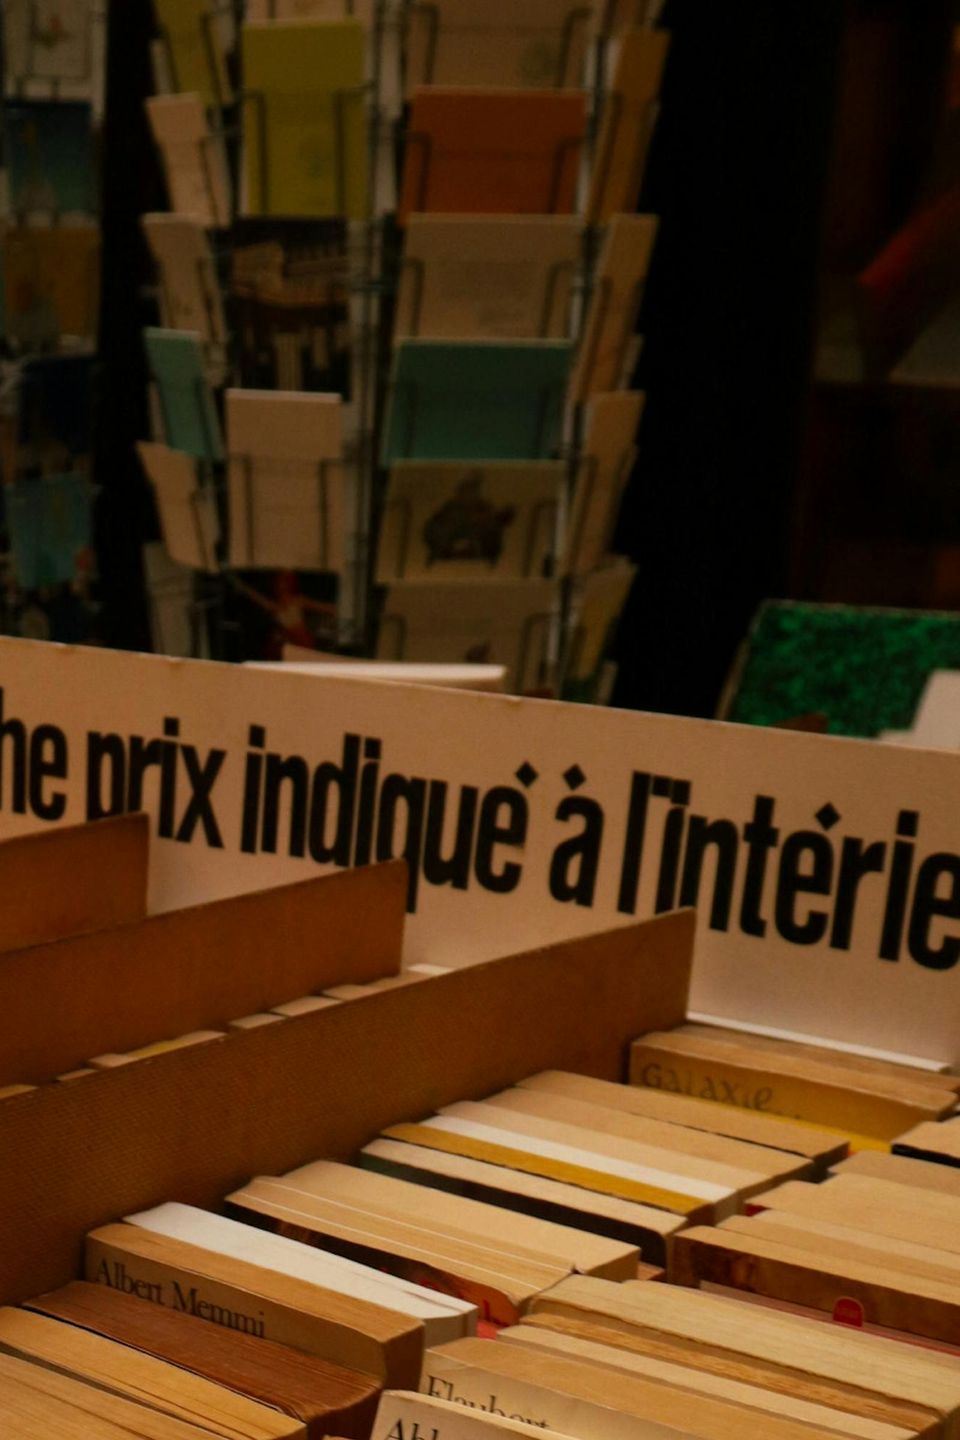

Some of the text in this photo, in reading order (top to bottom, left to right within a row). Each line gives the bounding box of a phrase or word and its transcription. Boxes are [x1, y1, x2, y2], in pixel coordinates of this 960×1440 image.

[87, 716, 226, 849] prix
[549, 764, 604, 908] à
[97, 1257, 266, 1338] Albert Memmi
